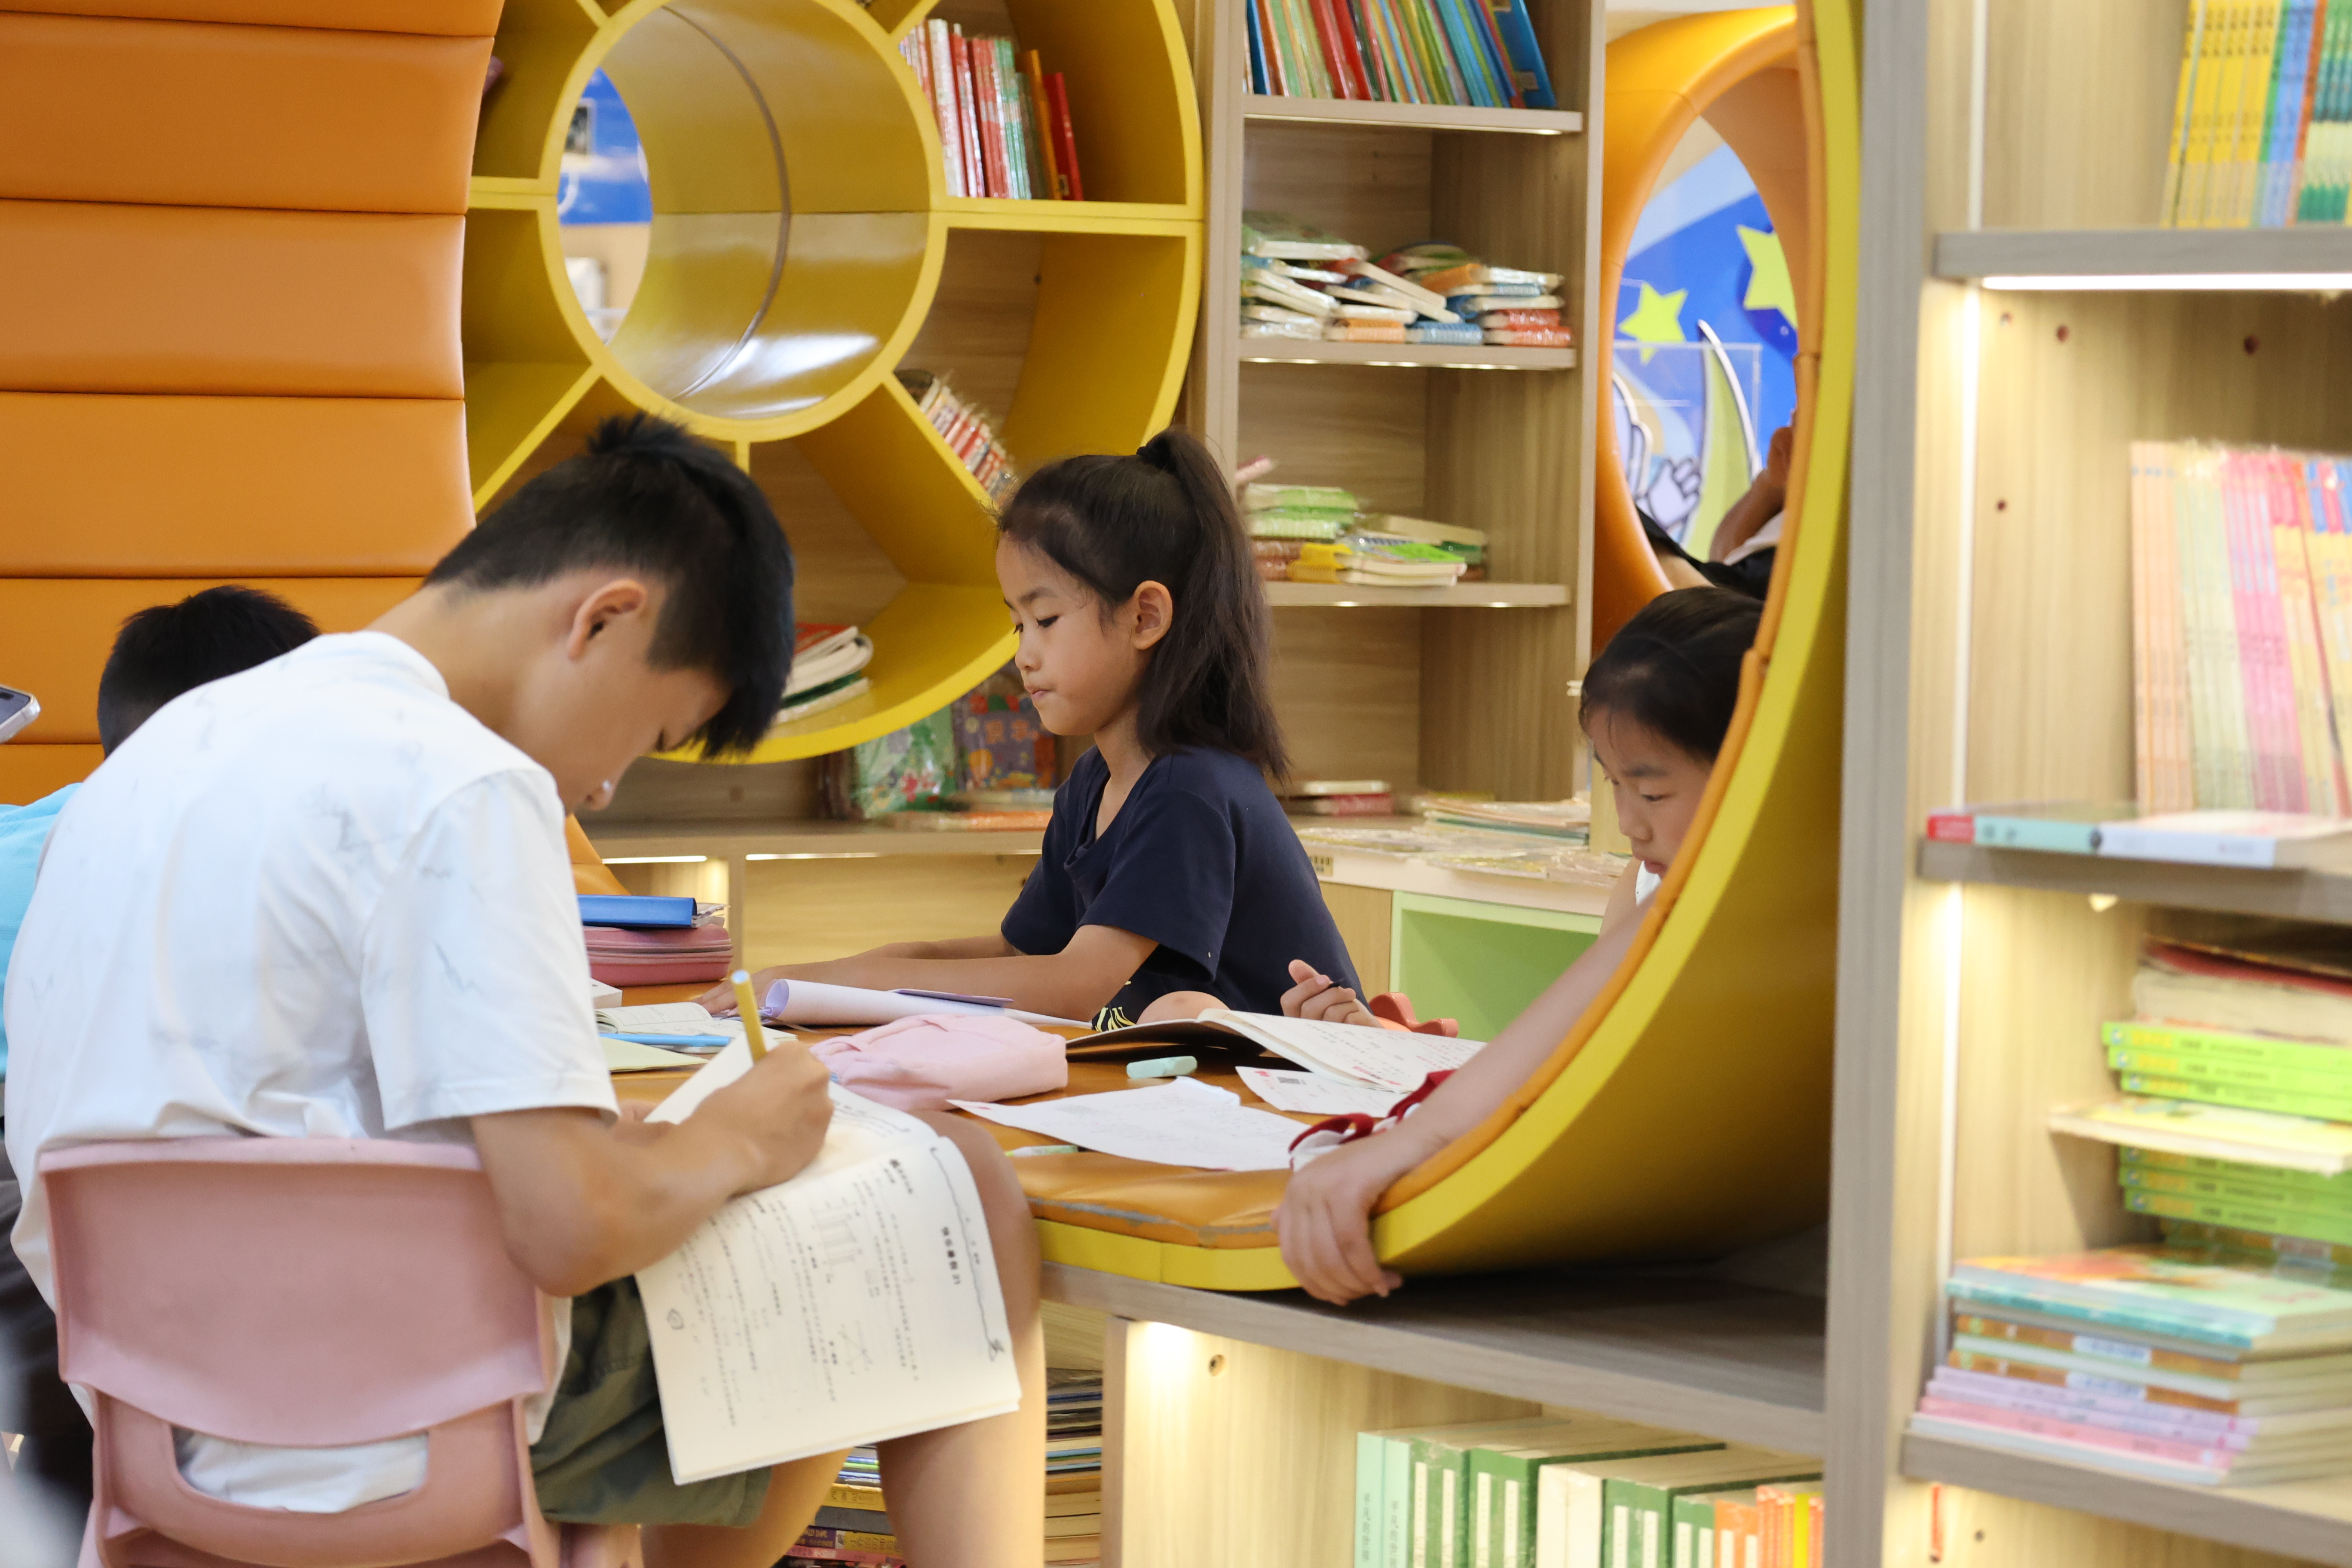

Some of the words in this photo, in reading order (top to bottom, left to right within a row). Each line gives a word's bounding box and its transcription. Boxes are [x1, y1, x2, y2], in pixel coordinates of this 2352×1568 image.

[1361, 1492, 1370, 1563] 平凡的世界
